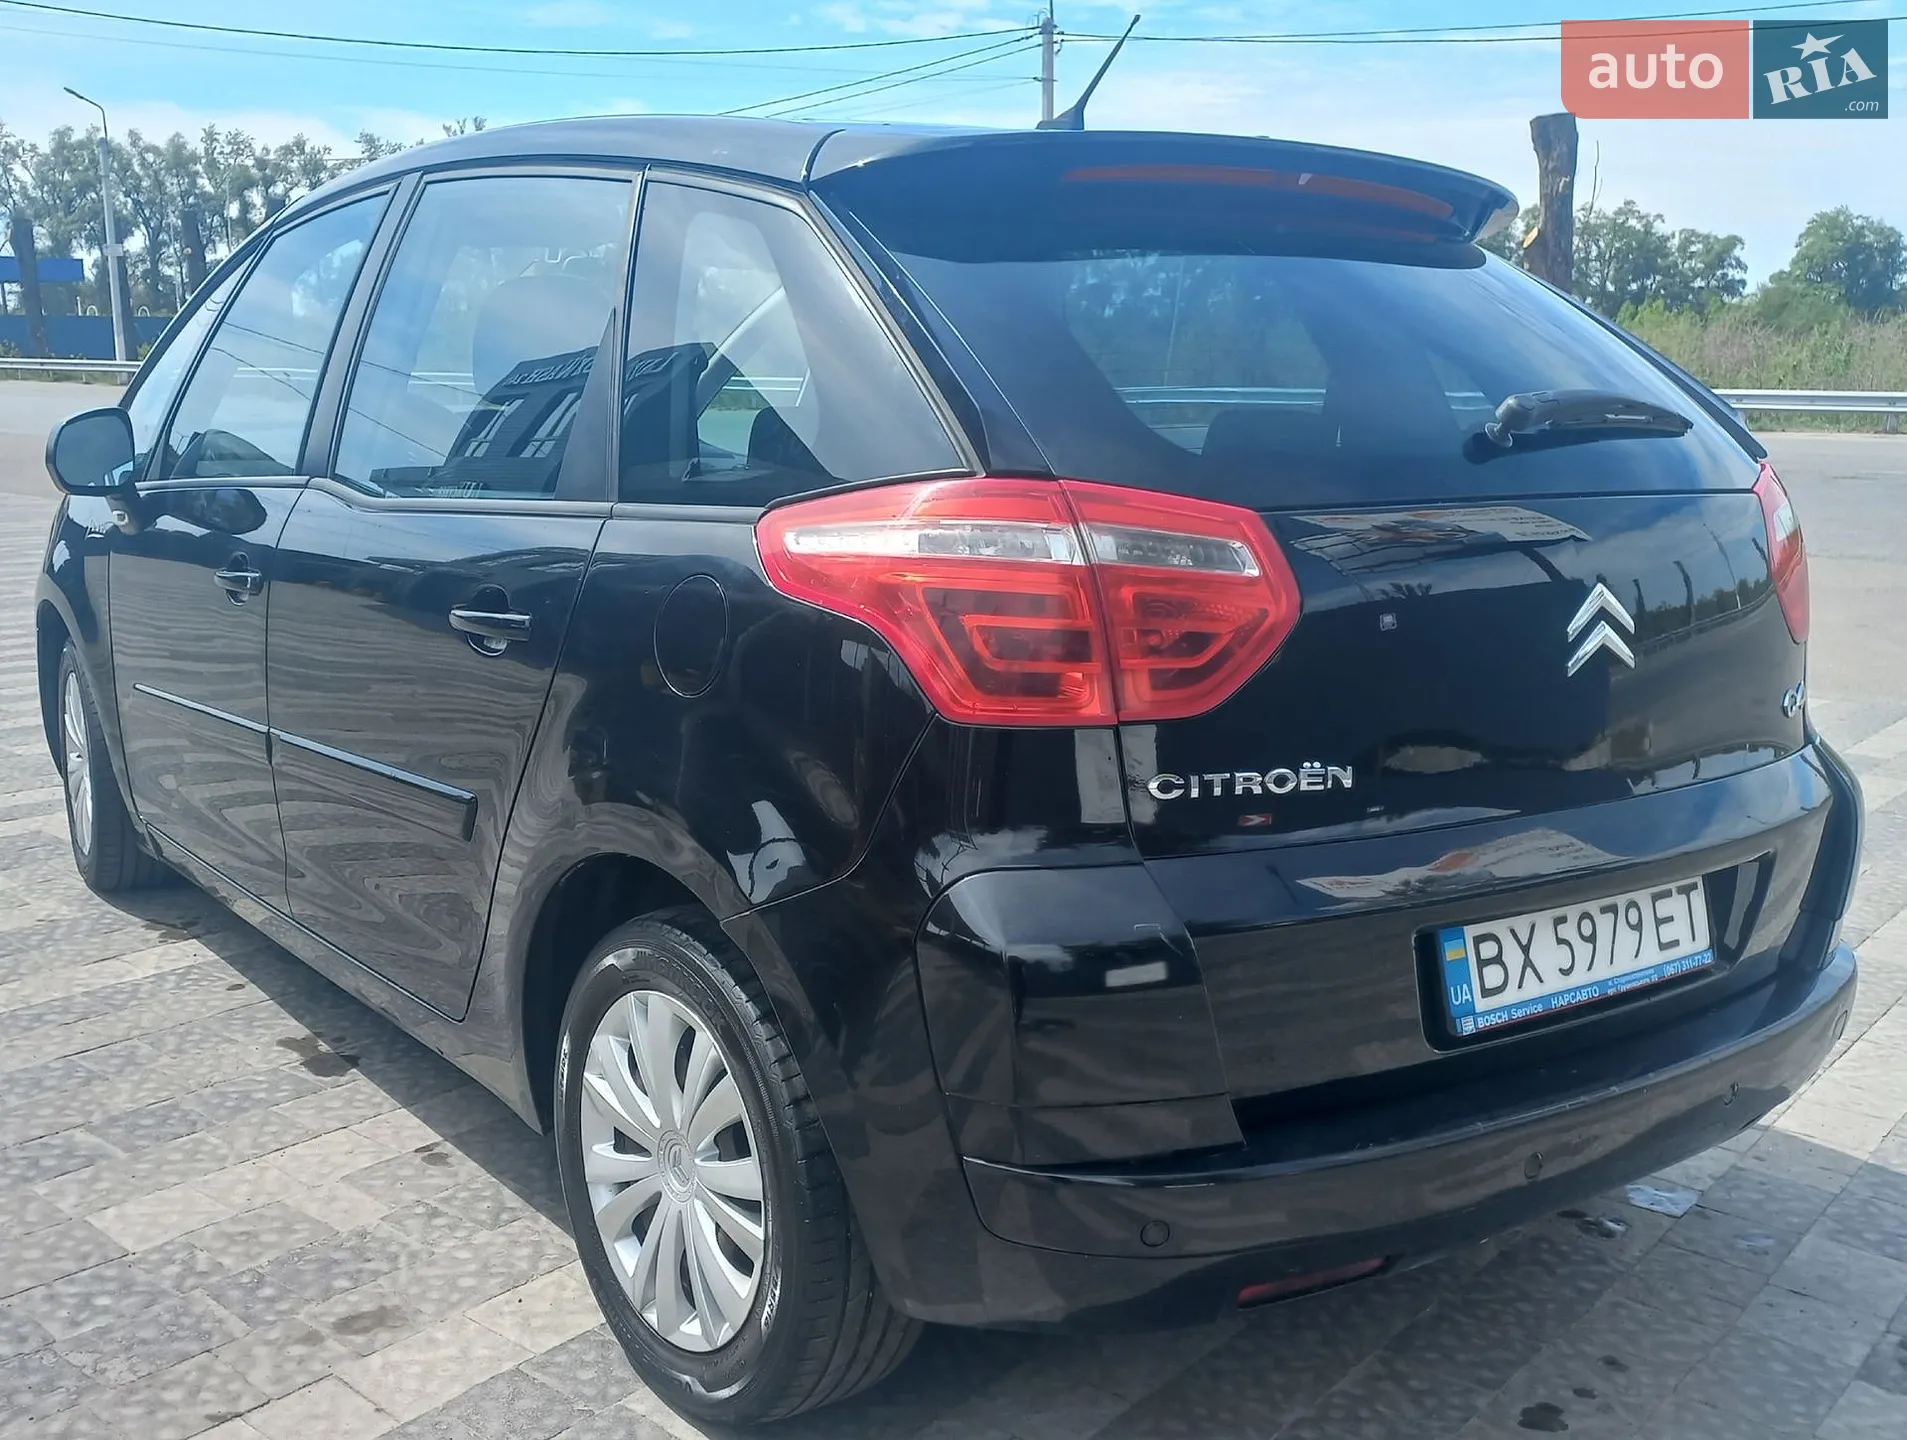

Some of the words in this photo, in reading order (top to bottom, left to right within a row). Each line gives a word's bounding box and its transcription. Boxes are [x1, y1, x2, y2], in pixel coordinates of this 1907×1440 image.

[1147, 761, 1353, 800] CITROËN
[1472, 922, 1544, 999] BX
[1553, 899, 1643, 977] 5979
[1651, 881, 1699, 952] ET
[1450, 983, 1472, 1006] UA
[1477, 1010, 1509, 1028] BOSCH
[1511, 1003, 1543, 1019] Service
